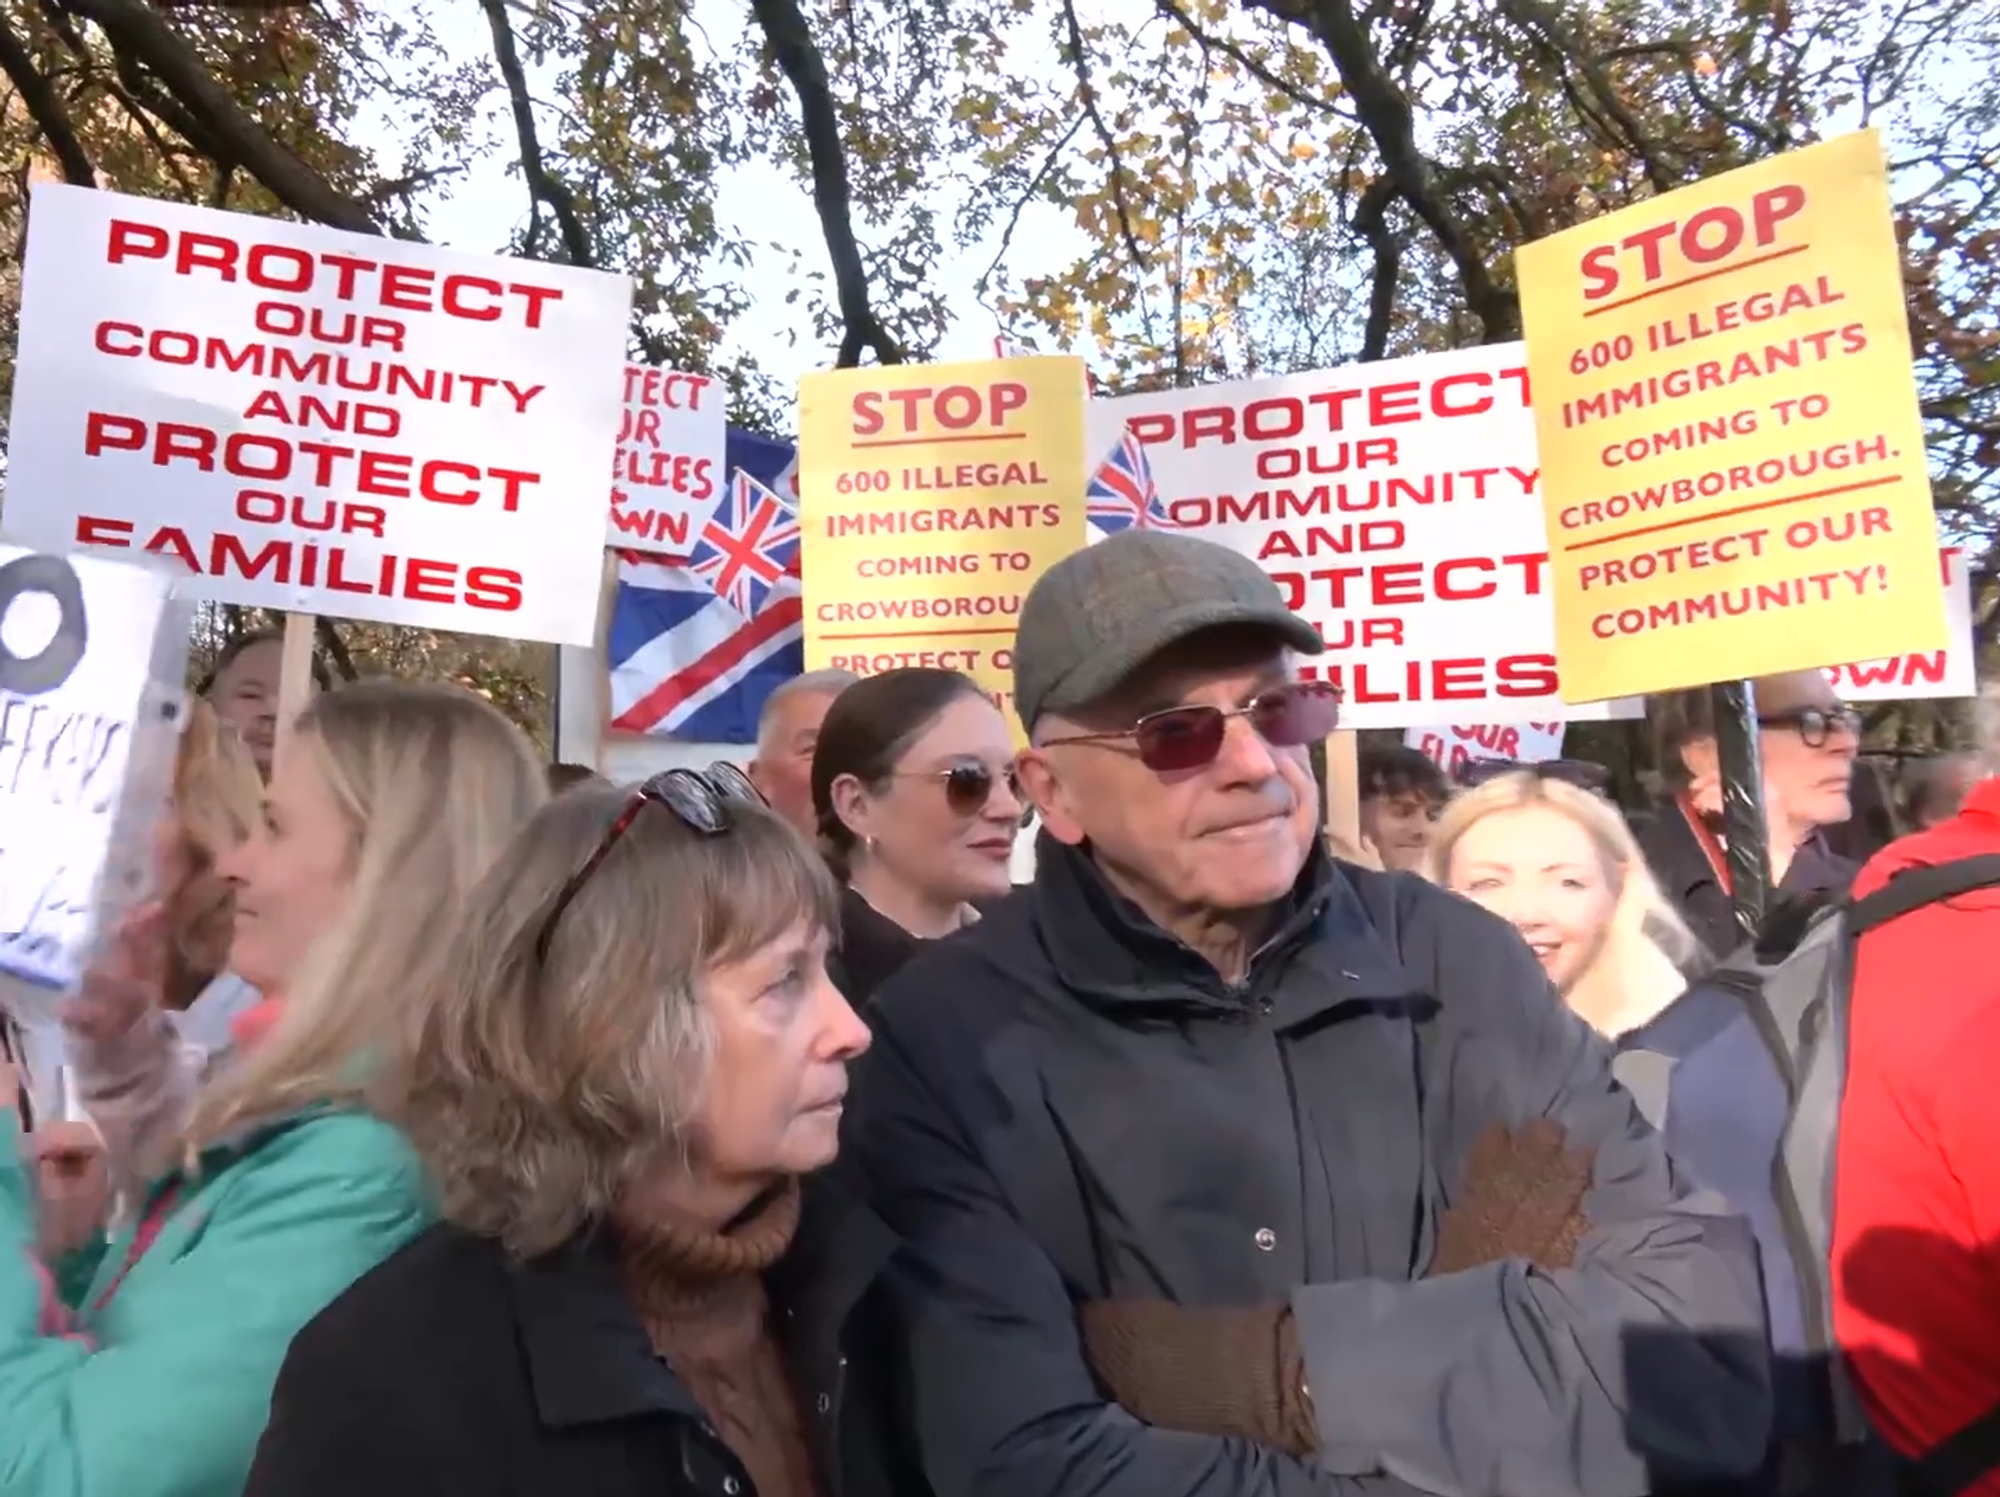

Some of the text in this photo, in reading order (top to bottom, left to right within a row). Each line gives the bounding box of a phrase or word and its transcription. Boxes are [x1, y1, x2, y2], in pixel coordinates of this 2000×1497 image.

[1580, 184, 1807, 300] STOP
[106, 218, 564, 330] PROTECT
[254, 301, 407, 353] OUR
[1569, 276, 1846, 376] 600 ILLEGAL
[94, 319, 547, 415] COMMUNITY
[623, 367, 710, 411] TECT
[1561, 322, 1868, 430] IMMIGRANTS
[242, 389, 402, 439] AND
[852, 382, 1028, 436] STOP
[1126, 367, 1531, 449] PROTECT
[1600, 393, 1830, 469] COMING TO
[84, 411, 542, 513] PROTECT
[836, 461, 1049, 494] 600 ILLEGAL
[1256, 437, 1399, 480] OUR
[1558, 434, 1901, 531] CROWBOROUGH.
[235, 488, 387, 539] OUR
[826, 504, 1061, 538] IMMIGRANTS
[1170, 467, 1540, 527] OMMUNITY
[74, 514, 524, 613] FAMILIES
[857, 550, 1032, 578] COMING TO
[1257, 520, 1406, 560] AND
[1578, 506, 1893, 592] PROTECT OUR
[817, 596, 1020, 622] CROWBOROU
[1590, 564, 1888, 640] COMMUNITY!
[1313, 617, 1404, 650] UR
